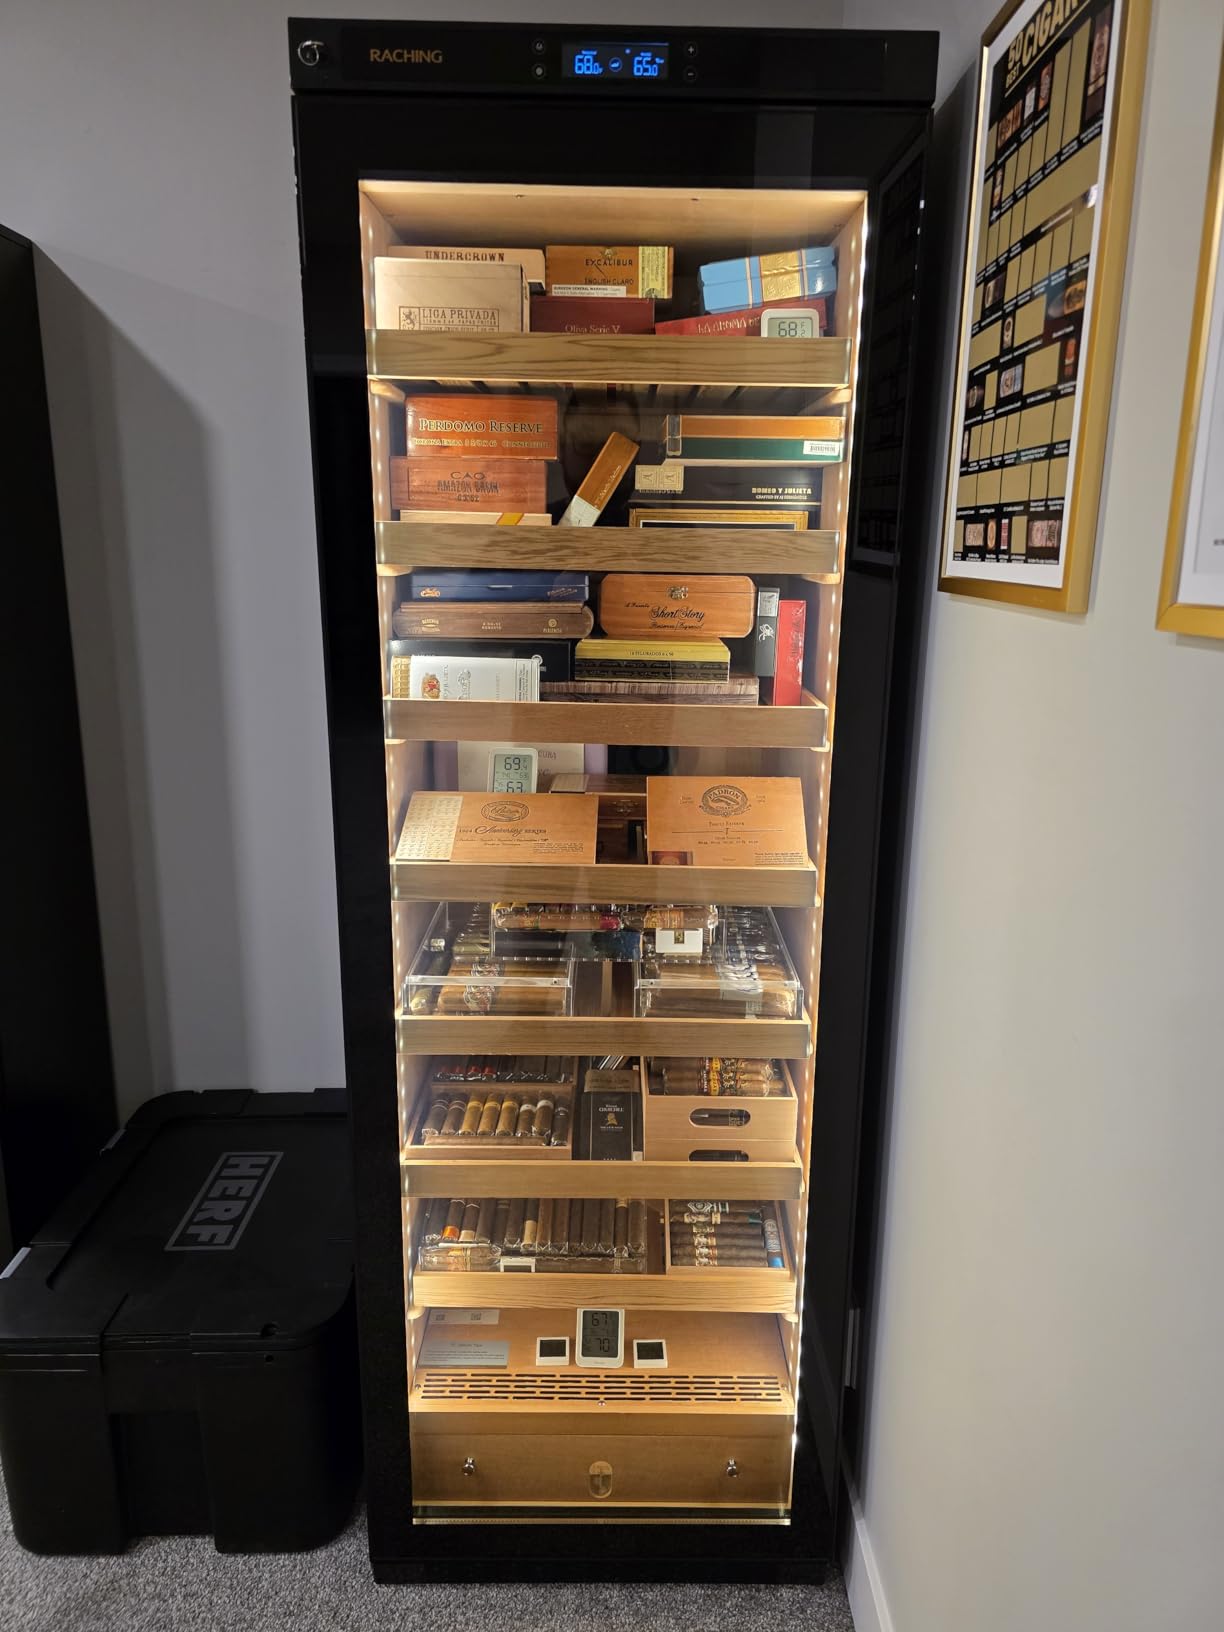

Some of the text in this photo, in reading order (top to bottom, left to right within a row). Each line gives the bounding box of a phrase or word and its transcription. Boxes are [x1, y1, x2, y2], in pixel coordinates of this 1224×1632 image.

[369, 48, 443, 64] RACHING
[425, 250, 505, 262] UNDERCROWN
[585, 258, 634, 267] EXCALIBUR
[421, 308, 497, 321] LIGA PRIVADA
[418, 418, 544, 434] PERDOMO RESERVE
[450, 471, 486, 480] CAO
[649, 605, 705, 623] Short Story
[186, 1155, 271, 1245] HERF
[591, 1312, 608, 1327] 67
